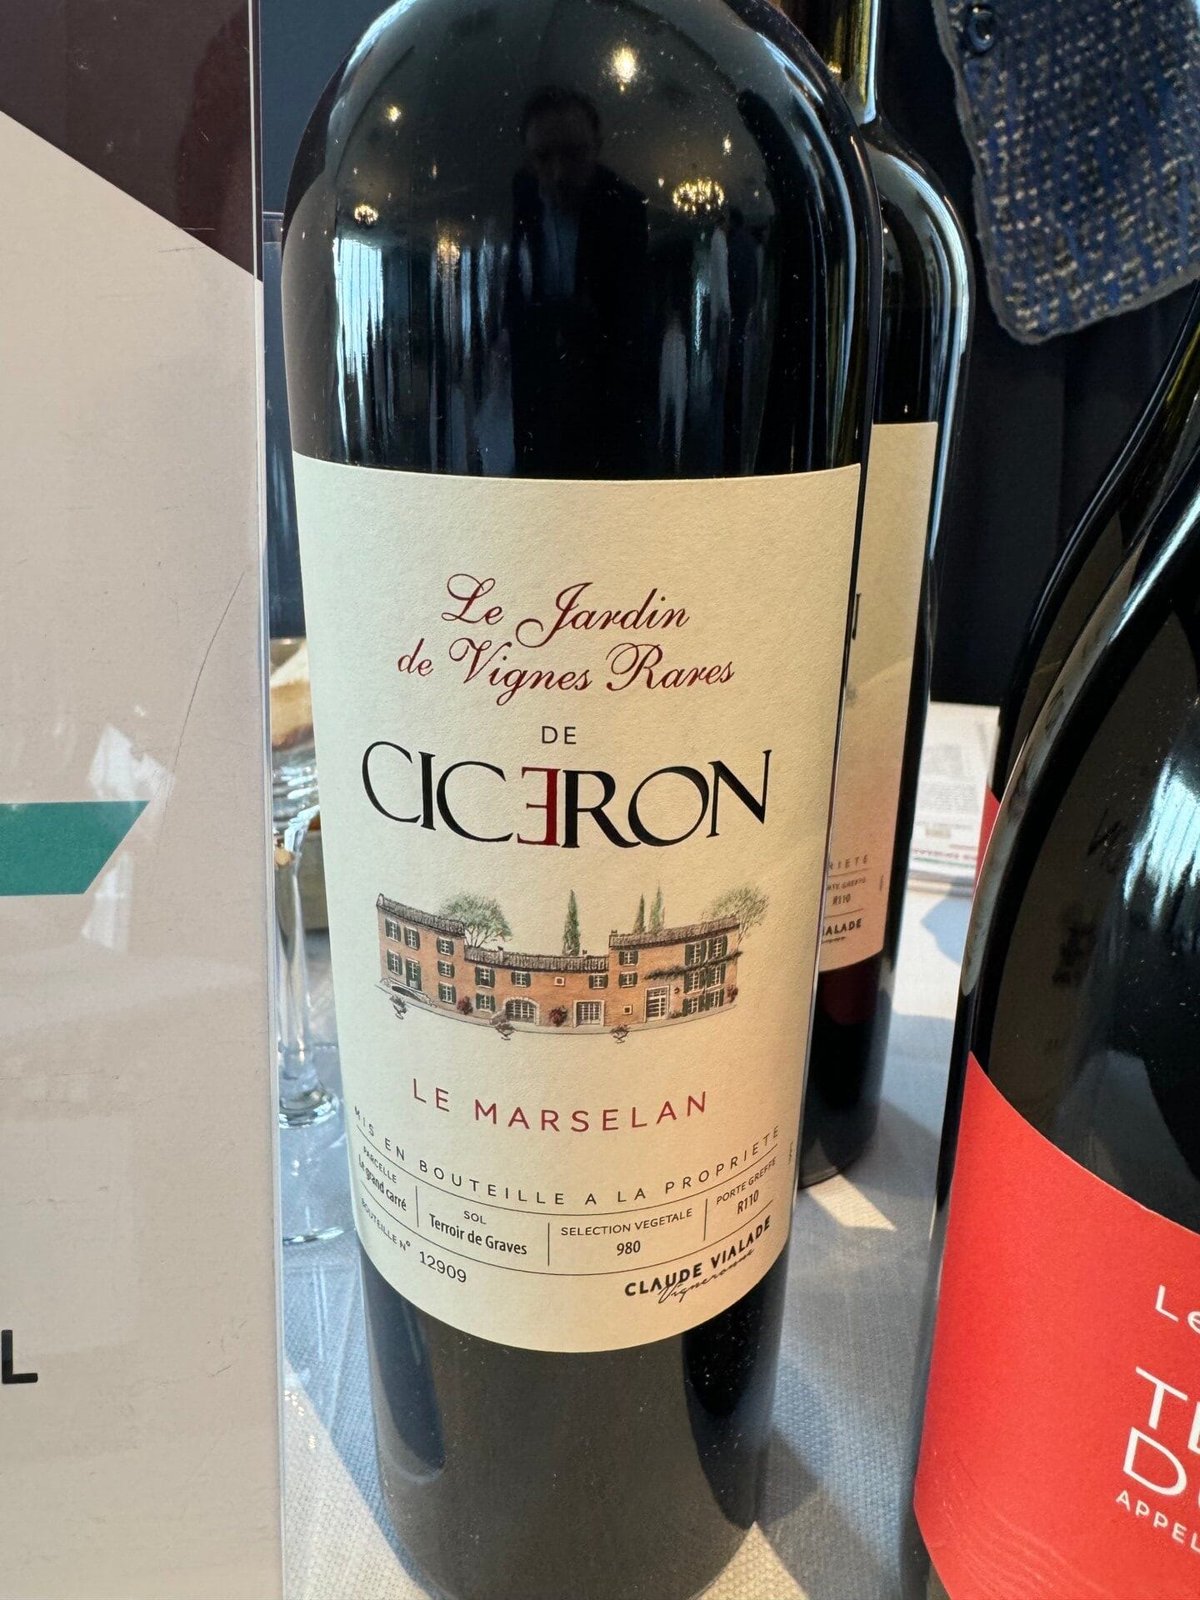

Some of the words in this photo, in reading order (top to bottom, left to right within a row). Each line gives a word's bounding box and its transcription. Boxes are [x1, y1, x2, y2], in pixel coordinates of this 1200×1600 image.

[441, 573, 504, 626] Le
[515, 581, 690, 649] Jardin
[397, 638, 434, 678] de
[448, 637, 593, 706] Vignes
[606, 642, 735, 692] Rares
[541, 726, 577, 745] DE
[413, 1077, 450, 1112] LE
[474, 1091, 707, 1132] MARSELAN
[354, 1105, 376, 1138] MIS
[384, 1136, 406, 1161] EN
[419, 1159, 565, 1206] BOUTEILLE
[584, 1192, 598, 1206] A
[617, 1187, 646, 1204] LA
[665, 1125, 780, 1195] PROPRIETE
[362, 1146, 398, 1184] PARCELLE
[364, 1167, 386, 1196] grand
[385, 1187, 408, 1213] carré
[716, 1181, 746, 1205] PORTE
[748, 1156, 777, 1186] GREFFE
[737, 1189, 760, 1215] R110
[361, 1197, 398, 1244] BOUTEILLE
[428, 1213, 466, 1241] Terroir
[466, 1230, 484, 1248] de
[484, 1233, 529, 1257] Graves
[463, 1209, 488, 1226] SOL
[560, 1222, 632, 1237] SELECTION
[634, 1207, 694, 1231] VEGETALE
[419, 1251, 468, 1285] 12909
[616, 1240, 642, 1257] 980
[624, 1262, 703, 1297] CLAUDE
[710, 1214, 772, 1269] VIALADE
